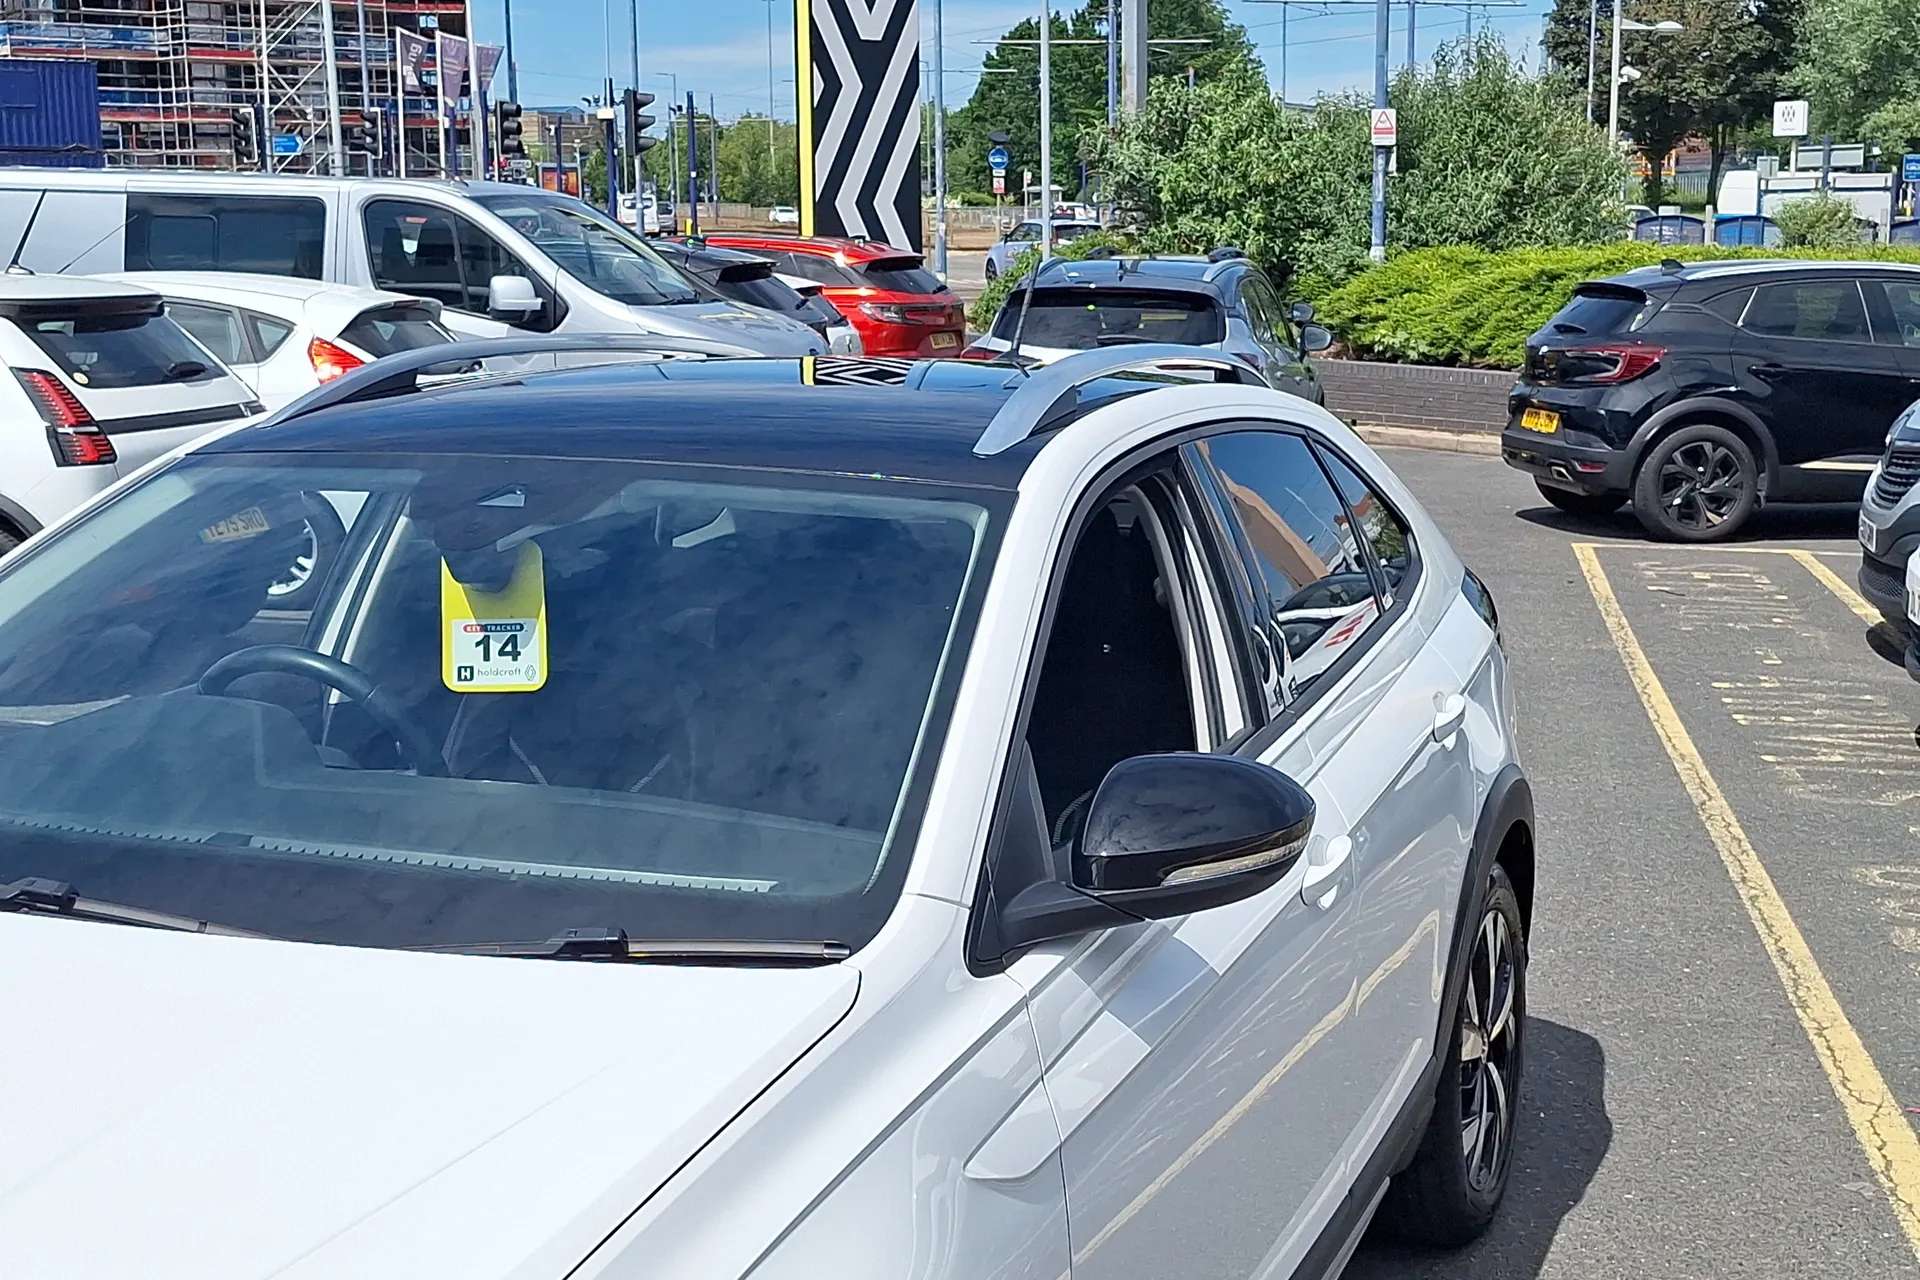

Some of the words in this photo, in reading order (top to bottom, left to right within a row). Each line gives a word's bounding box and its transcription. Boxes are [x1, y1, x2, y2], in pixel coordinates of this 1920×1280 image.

[475, 634, 521, 662] 14
[459, 666, 472, 681] H
[477, 667, 521, 677] holdcroft
